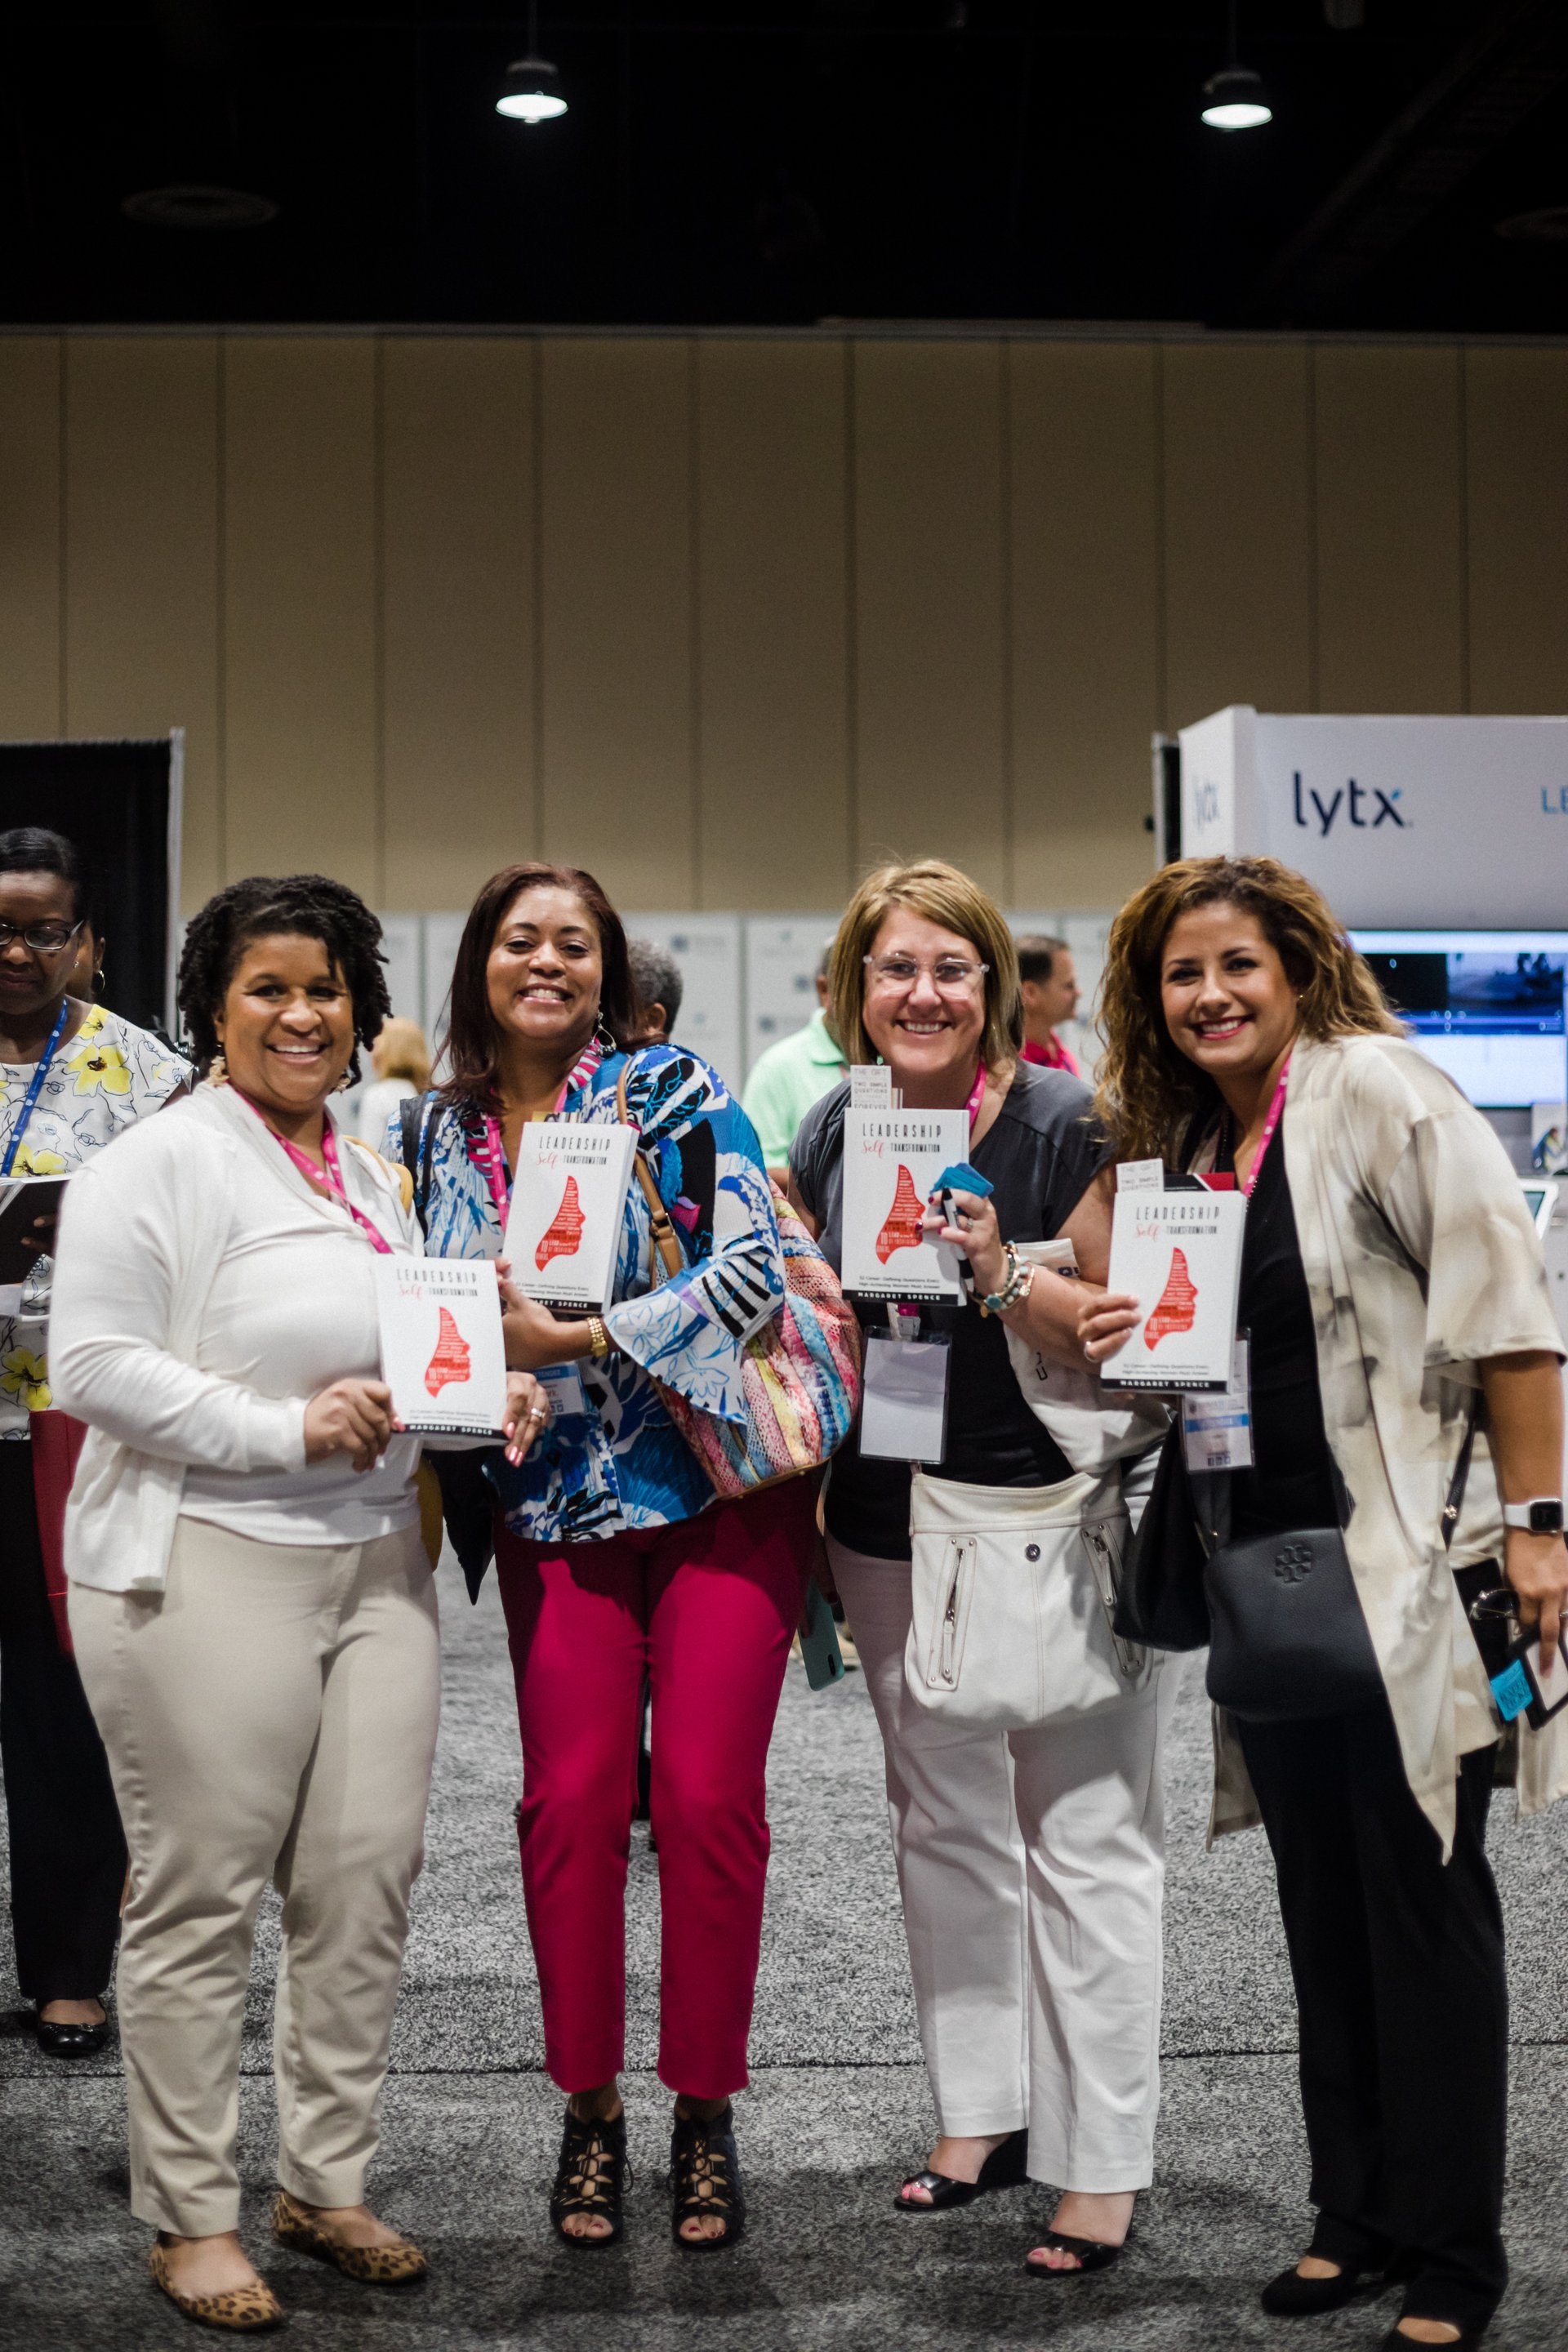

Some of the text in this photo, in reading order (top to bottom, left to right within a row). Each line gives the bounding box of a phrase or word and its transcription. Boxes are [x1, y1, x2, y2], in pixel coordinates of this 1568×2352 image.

[1294, 771, 1404, 836] lytx
[862, 1123, 942, 1138] LEADERSHIP
[538, 1136, 611, 1151] LEADERSHIP
[862, 1139, 941, 1159] Self TRANSFORMATION
[536, 1152, 608, 1169] Self TRANSFORMATION
[1136, 1206, 1220, 1220] LEADERSHIP
[1166, 1226, 1217, 1235] TRANSFORMATION
[396, 1268, 477, 1283] LEADERSHIP
[858, 1291, 902, 1299] MARGARET
[558, 1300, 589, 1308] SPENCE
[1120, 1379, 1169, 1388] MARGARET
[409, 1423, 492, 1436] MARGARET SPENCE
